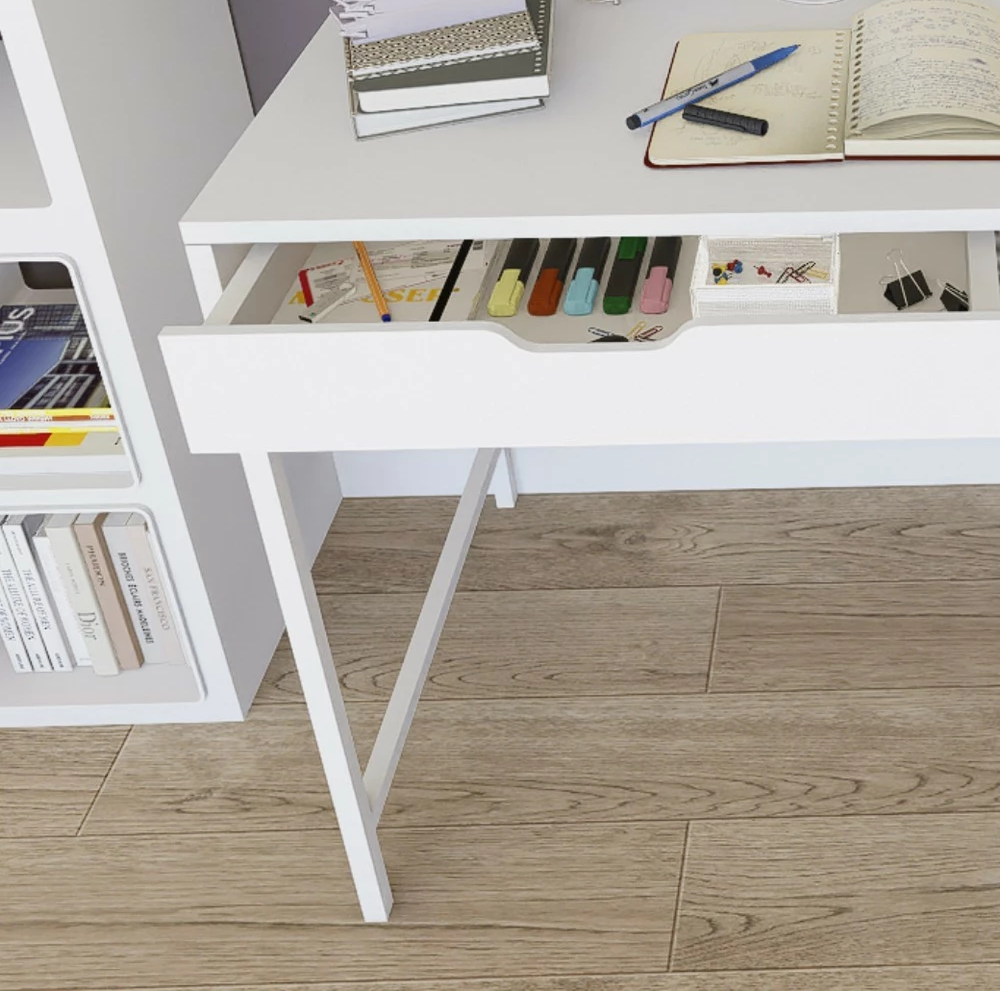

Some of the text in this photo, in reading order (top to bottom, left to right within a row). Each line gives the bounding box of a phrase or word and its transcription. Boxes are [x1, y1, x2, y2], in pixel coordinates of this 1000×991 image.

[144, 567, 172, 631] SAN FRANCISCO
[78, 612, 100, 642] Dior
